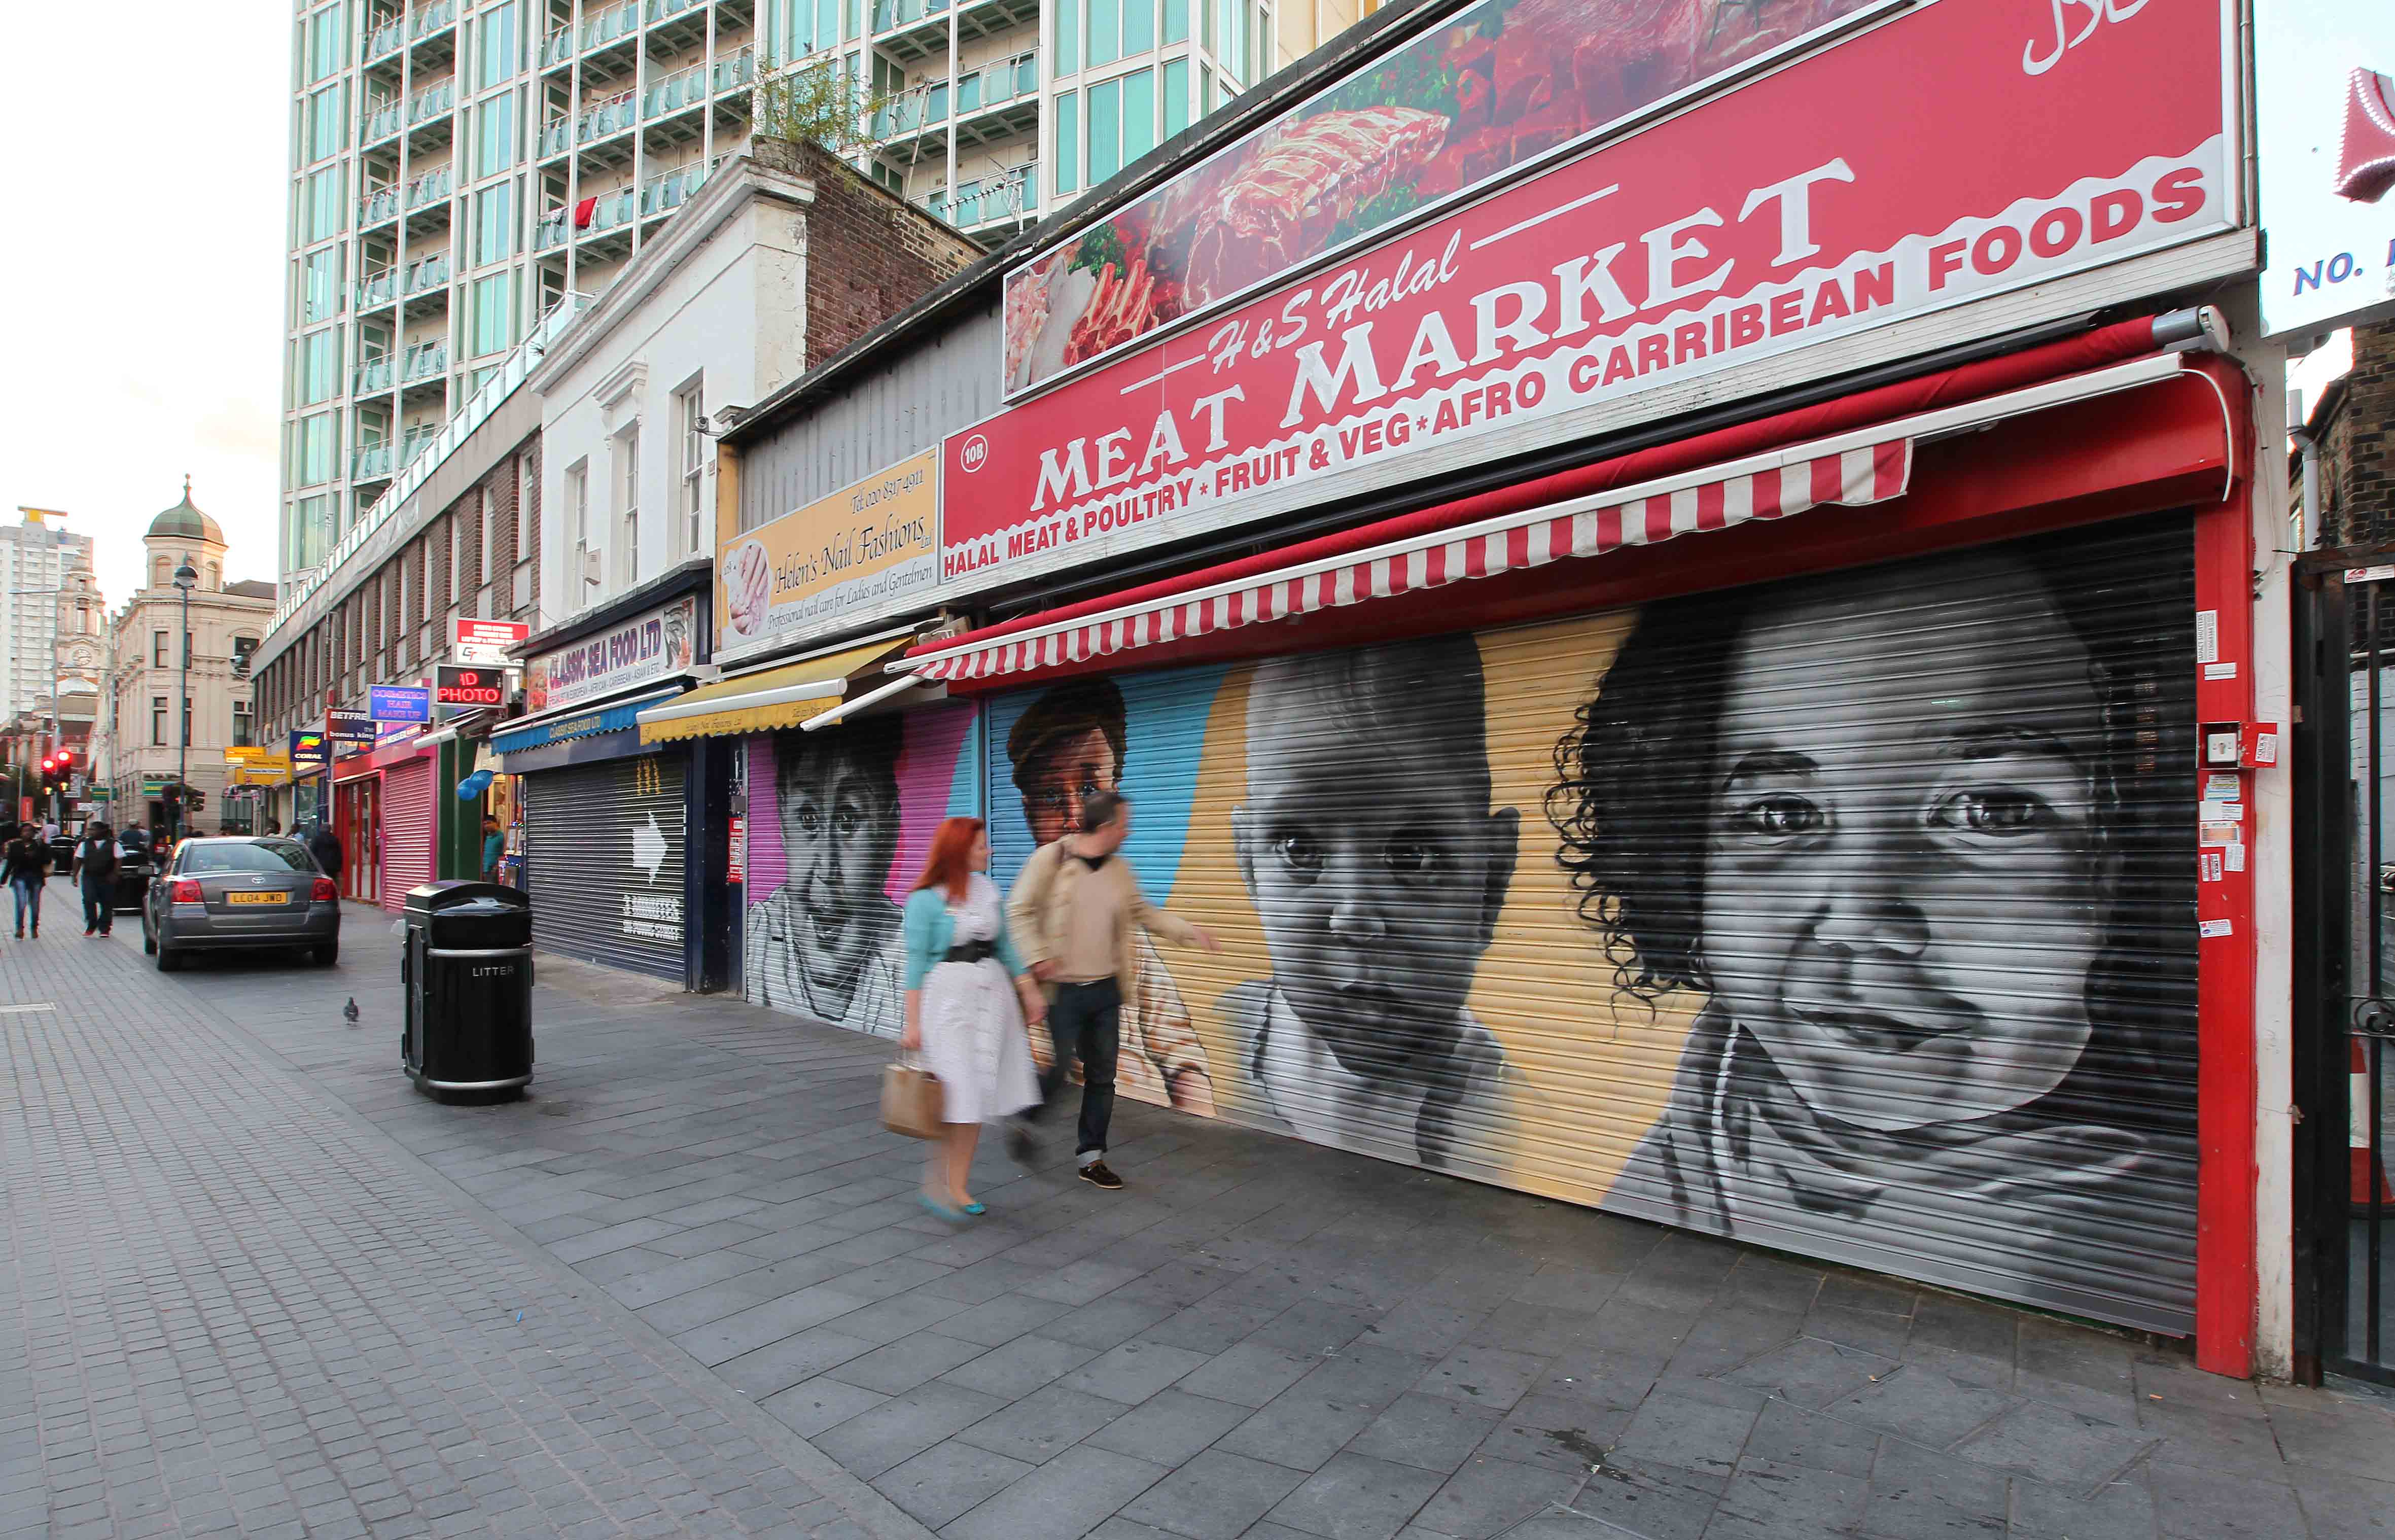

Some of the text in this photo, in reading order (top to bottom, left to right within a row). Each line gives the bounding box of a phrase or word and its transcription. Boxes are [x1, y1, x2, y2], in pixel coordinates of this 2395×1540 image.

[1320, 228, 1462, 330] Halal
[2292, 252, 2364, 297] NO.
[1030, 157, 1856, 511] MEAT MARKET
[944, 166, 2206, 577] HALAL MEAT & POULTRY FRUIT & VEG AFRO CARRIBEAN FOODS
[965, 443, 983, 465] 10B
[866, 488, 881, 507] 020
[902, 469, 924, 494] 4911
[775, 513, 924, 594] Helen's Nail Fashions
[767, 602, 804, 633] Professional
[804, 594, 820, 618] nail
[819, 599, 833, 613] care
[833, 586, 845, 614] for
[846, 579, 870, 605] Ladies
[871, 571, 888, 595] and
[549, 618, 662, 690] CLASSIC SEA FOOD LTD
[372, 689, 427, 699] COSMETICS
[438, 688, 500, 703] PHOTO
[459, 672, 479, 686] ID
[330, 711, 367, 720] BETFRE
[357, 731, 375, 740] king
[472, 966, 515, 977] LITTER
